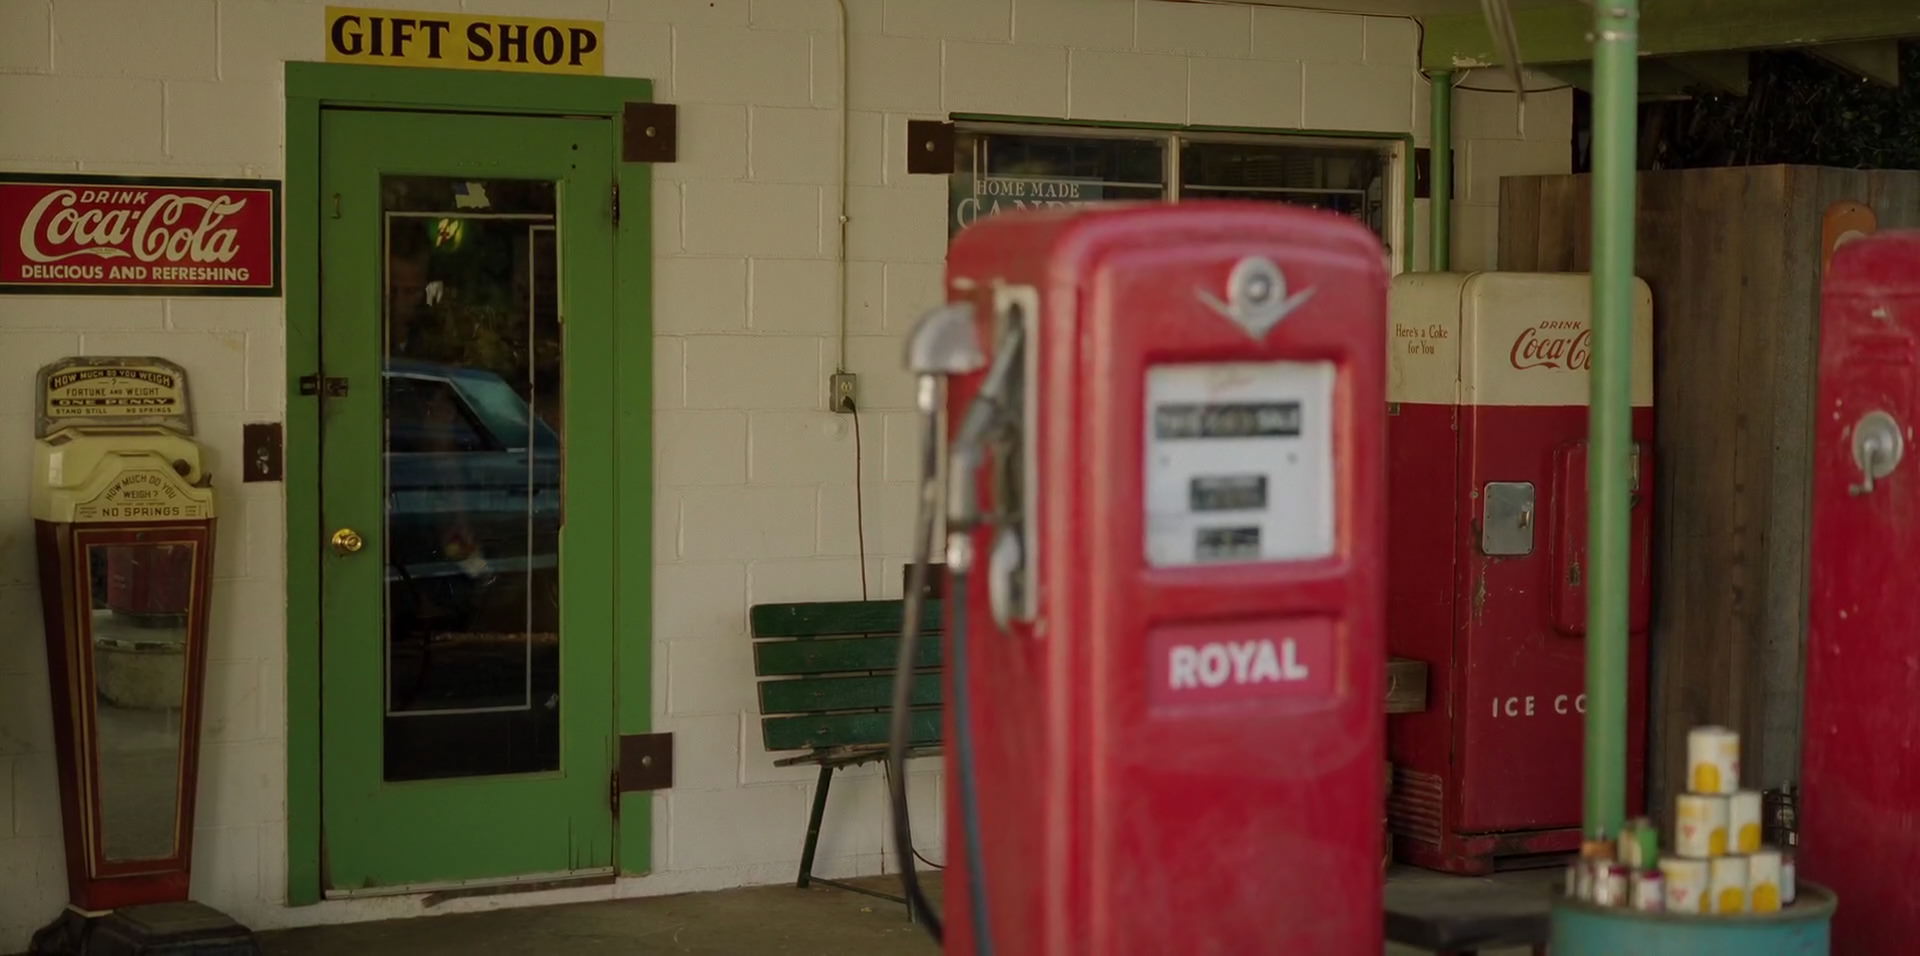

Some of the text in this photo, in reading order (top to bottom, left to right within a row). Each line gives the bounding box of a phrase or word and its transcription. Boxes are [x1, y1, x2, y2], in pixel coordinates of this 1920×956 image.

[331, 14, 597, 66] GIFT SHOP
[80, 190, 148, 205] DRINK
[977, 180, 1080, 198] HOME MADE
[20, 189, 247, 263] Coca-Cola
[21, 264, 249, 281] DELICIOUS AND REFRESHING
[1396, 323, 1448, 338] Here's a Coke
[1540, 320, 1582, 330] DRINK
[1408, 340, 1435, 354] for You
[1510, 327, 1592, 370] Coca-C
[54, 373, 77, 388] HOW
[80, 370, 104, 379] MUCH
[119, 370, 137, 379] YOU
[139, 371, 171, 387] WEIGH
[66, 388, 106, 397] FORTUNE
[126, 388, 159, 397] WEIGHT
[105, 398, 168, 406] PENNY
[106, 474, 177, 501] HOW MUCH DO YOU
[102, 507, 119, 517] NO
[124, 506, 180, 517] SPRINGS
[1168, 638, 1309, 690] ROYAL
[1492, 693, 1588, 718] ICE CO
